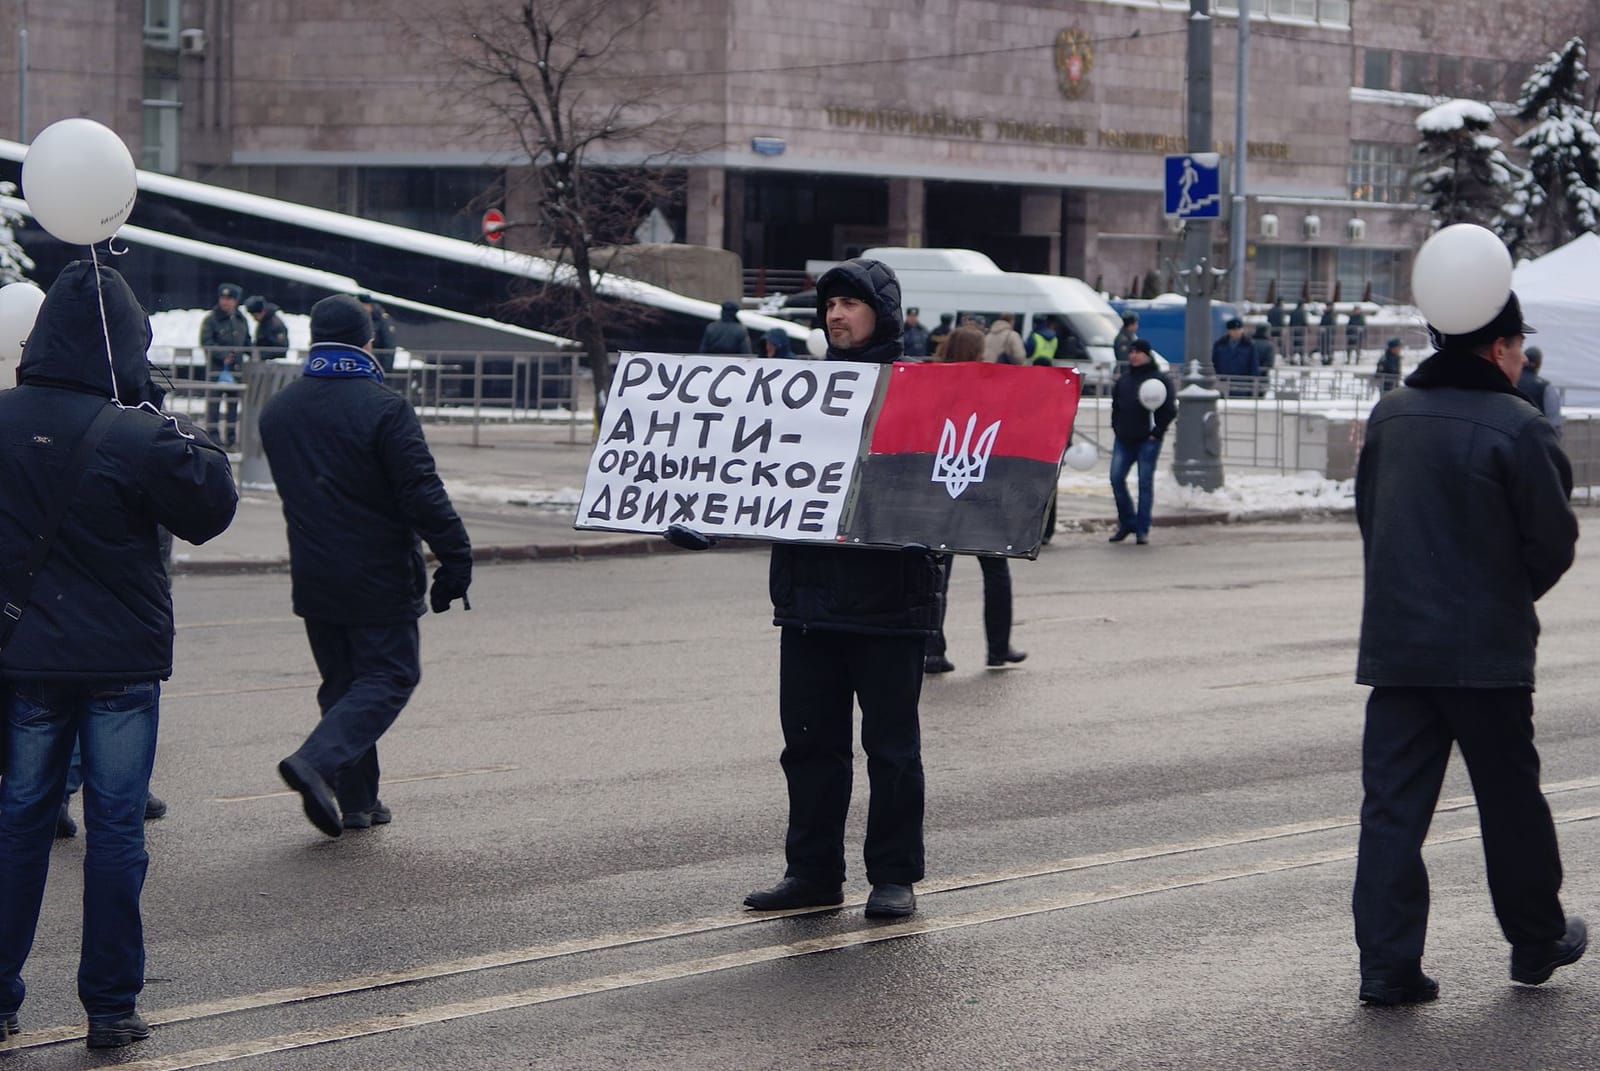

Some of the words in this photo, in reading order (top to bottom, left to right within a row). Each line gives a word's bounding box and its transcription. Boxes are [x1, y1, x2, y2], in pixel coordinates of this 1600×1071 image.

[617, 357, 860, 417] РУССКОЕ
[603, 407, 802, 454] АНТИ-
[598, 449, 845, 494] ОРДЫНСКОЕ
[587, 483, 829, 533] ДВИЖЕНИЕ
